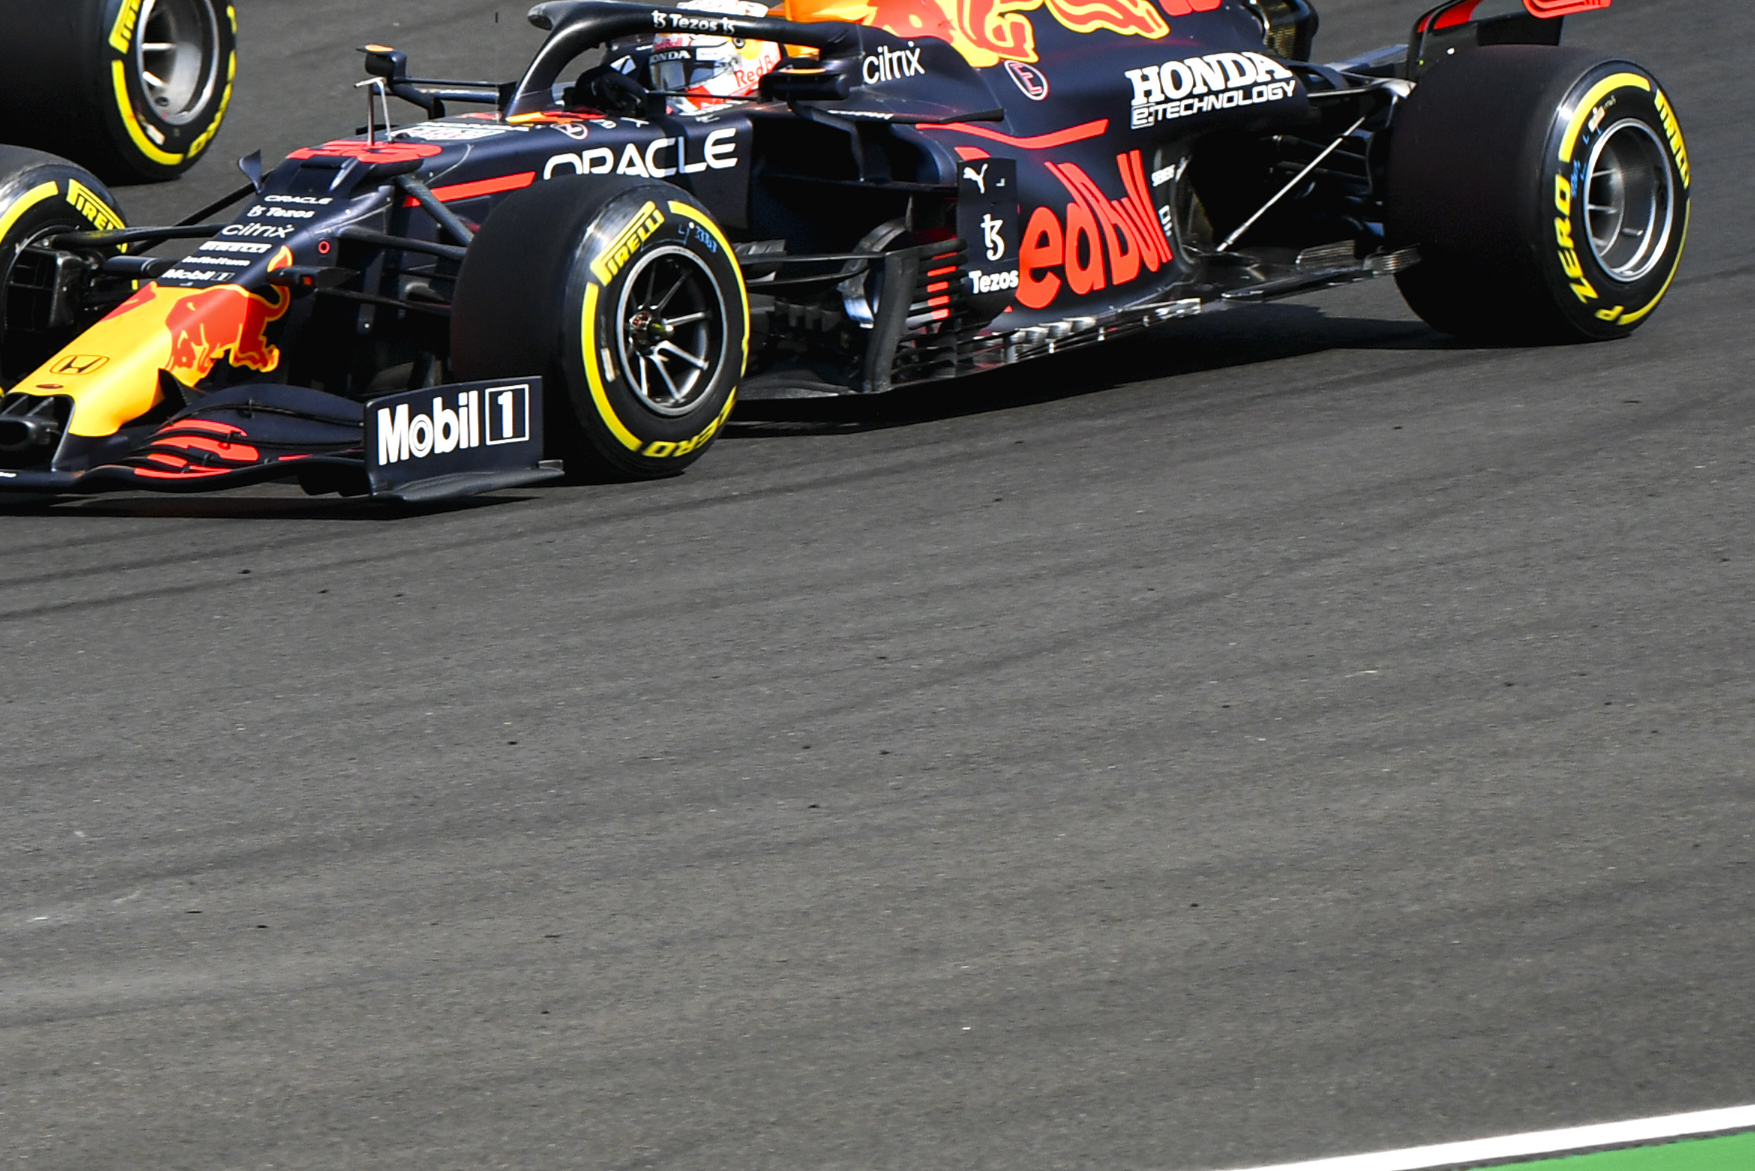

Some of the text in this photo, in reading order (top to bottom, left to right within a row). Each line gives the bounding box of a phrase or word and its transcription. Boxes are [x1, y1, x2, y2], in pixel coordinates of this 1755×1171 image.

[669, 13, 719, 31] Tezos
[650, 49, 691, 65] ONDA
[862, 41, 925, 84] citrix
[1125, 51, 1293, 107] HONDA
[264, 195, 333, 205] ORACLE
[266, 206, 316, 219] Tezos
[221, 223, 295, 239] citrix
[1554, 174, 1599, 304] ZERO
[198, 240, 273, 254] PIRELLI
[589, 200, 665, 287] PIRELLI
[161, 268, 214, 281] Mobil
[968, 269, 1020, 294] Tezos
[377, 390, 480, 467] Mobil
